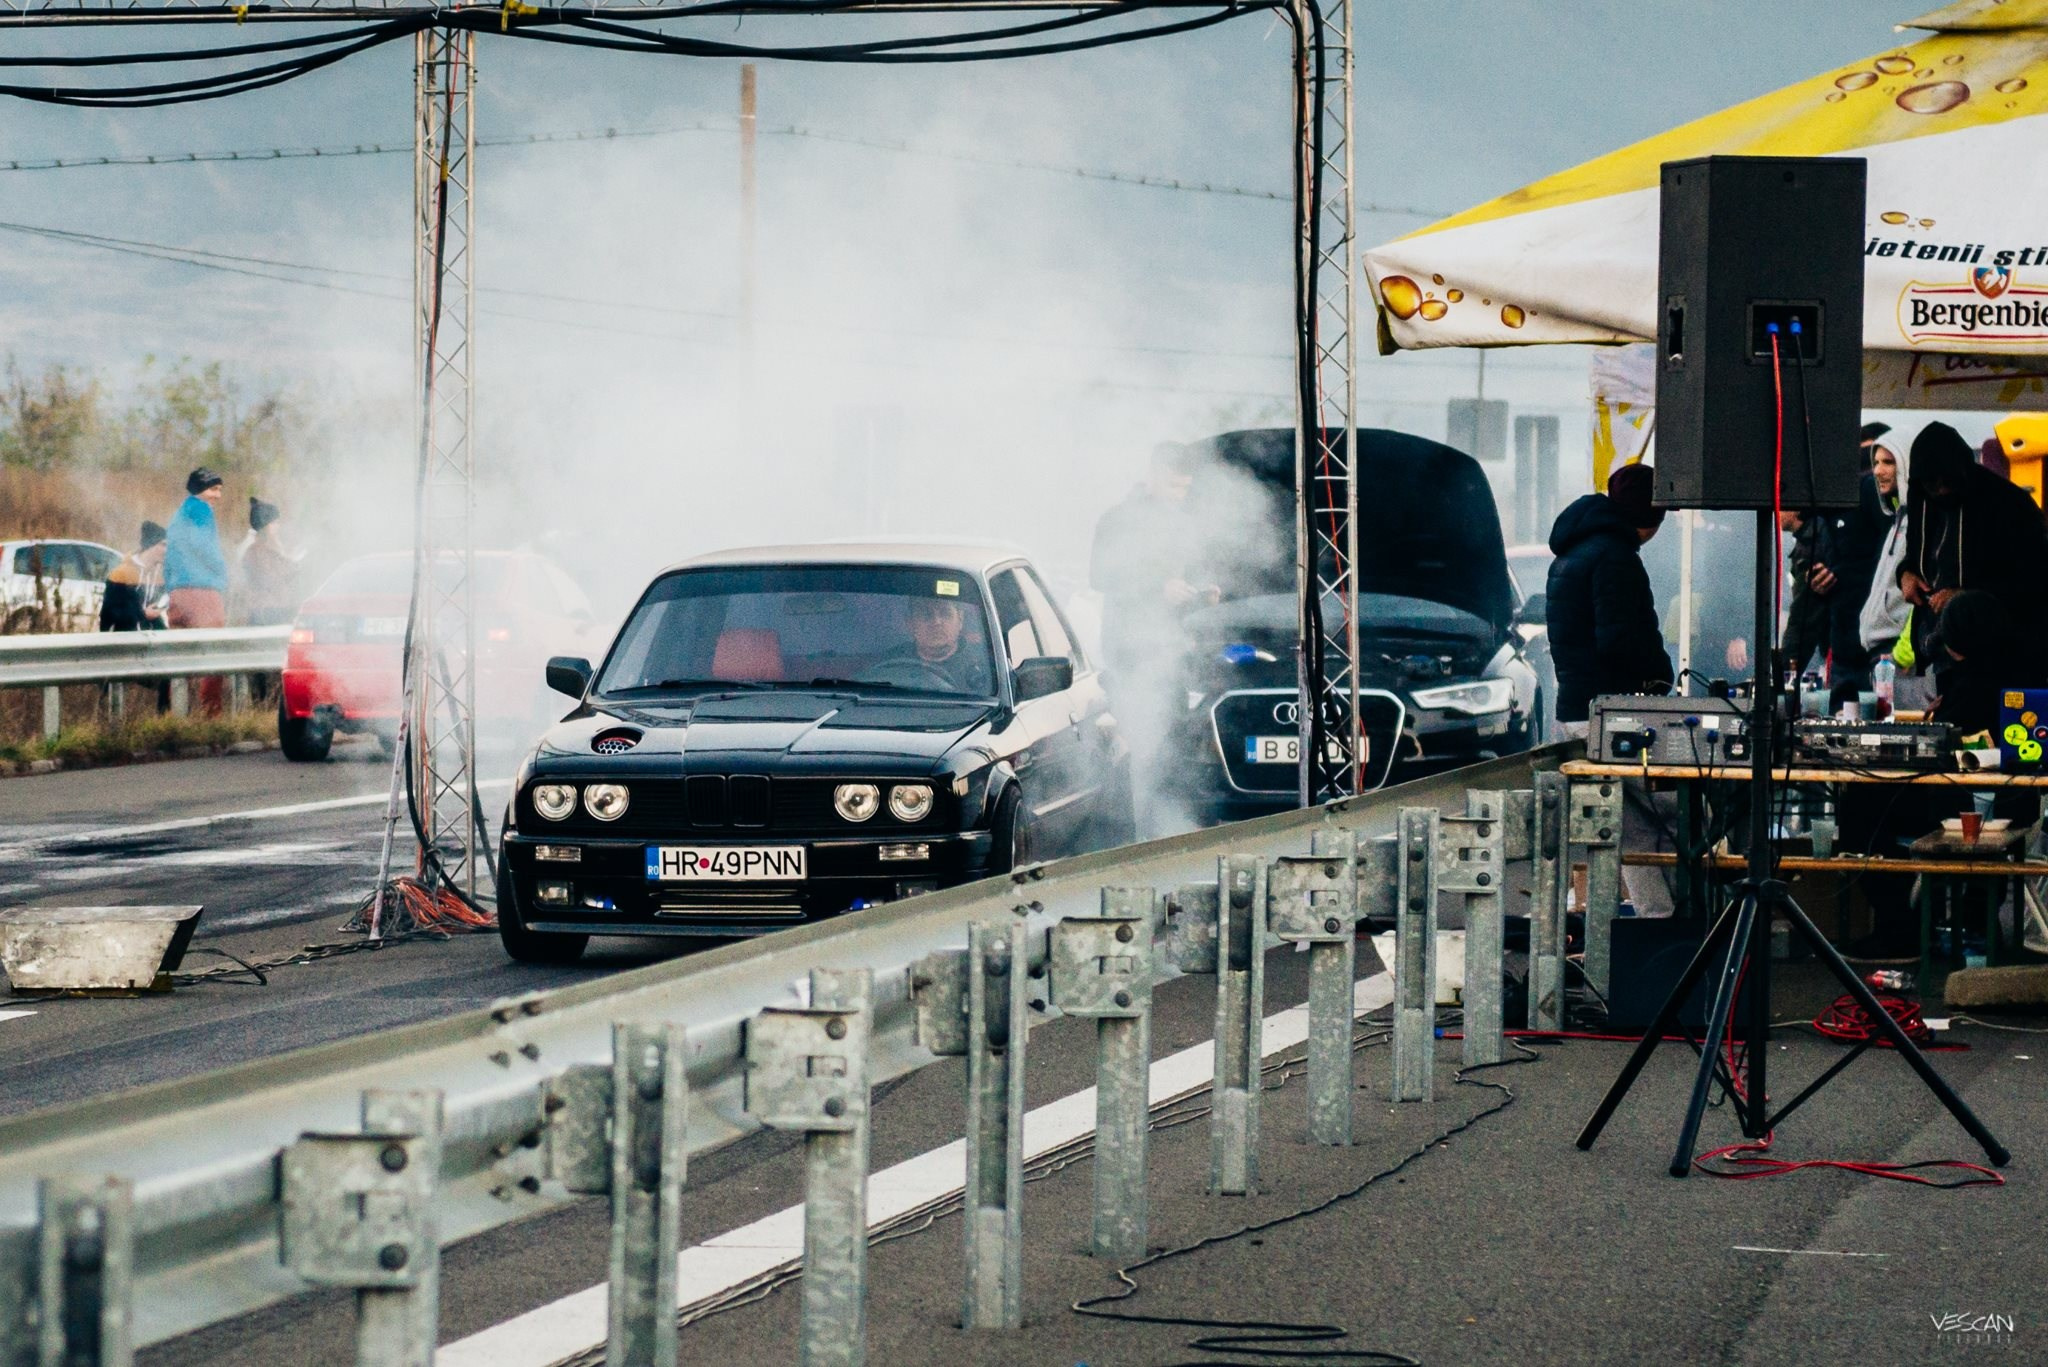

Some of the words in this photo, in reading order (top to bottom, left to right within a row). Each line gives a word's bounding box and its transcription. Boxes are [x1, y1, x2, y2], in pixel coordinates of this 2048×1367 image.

[1865, 237, 1984, 264] ietenii
[1993, 246, 2048, 266] sti
[648, 865, 660, 876] RO
